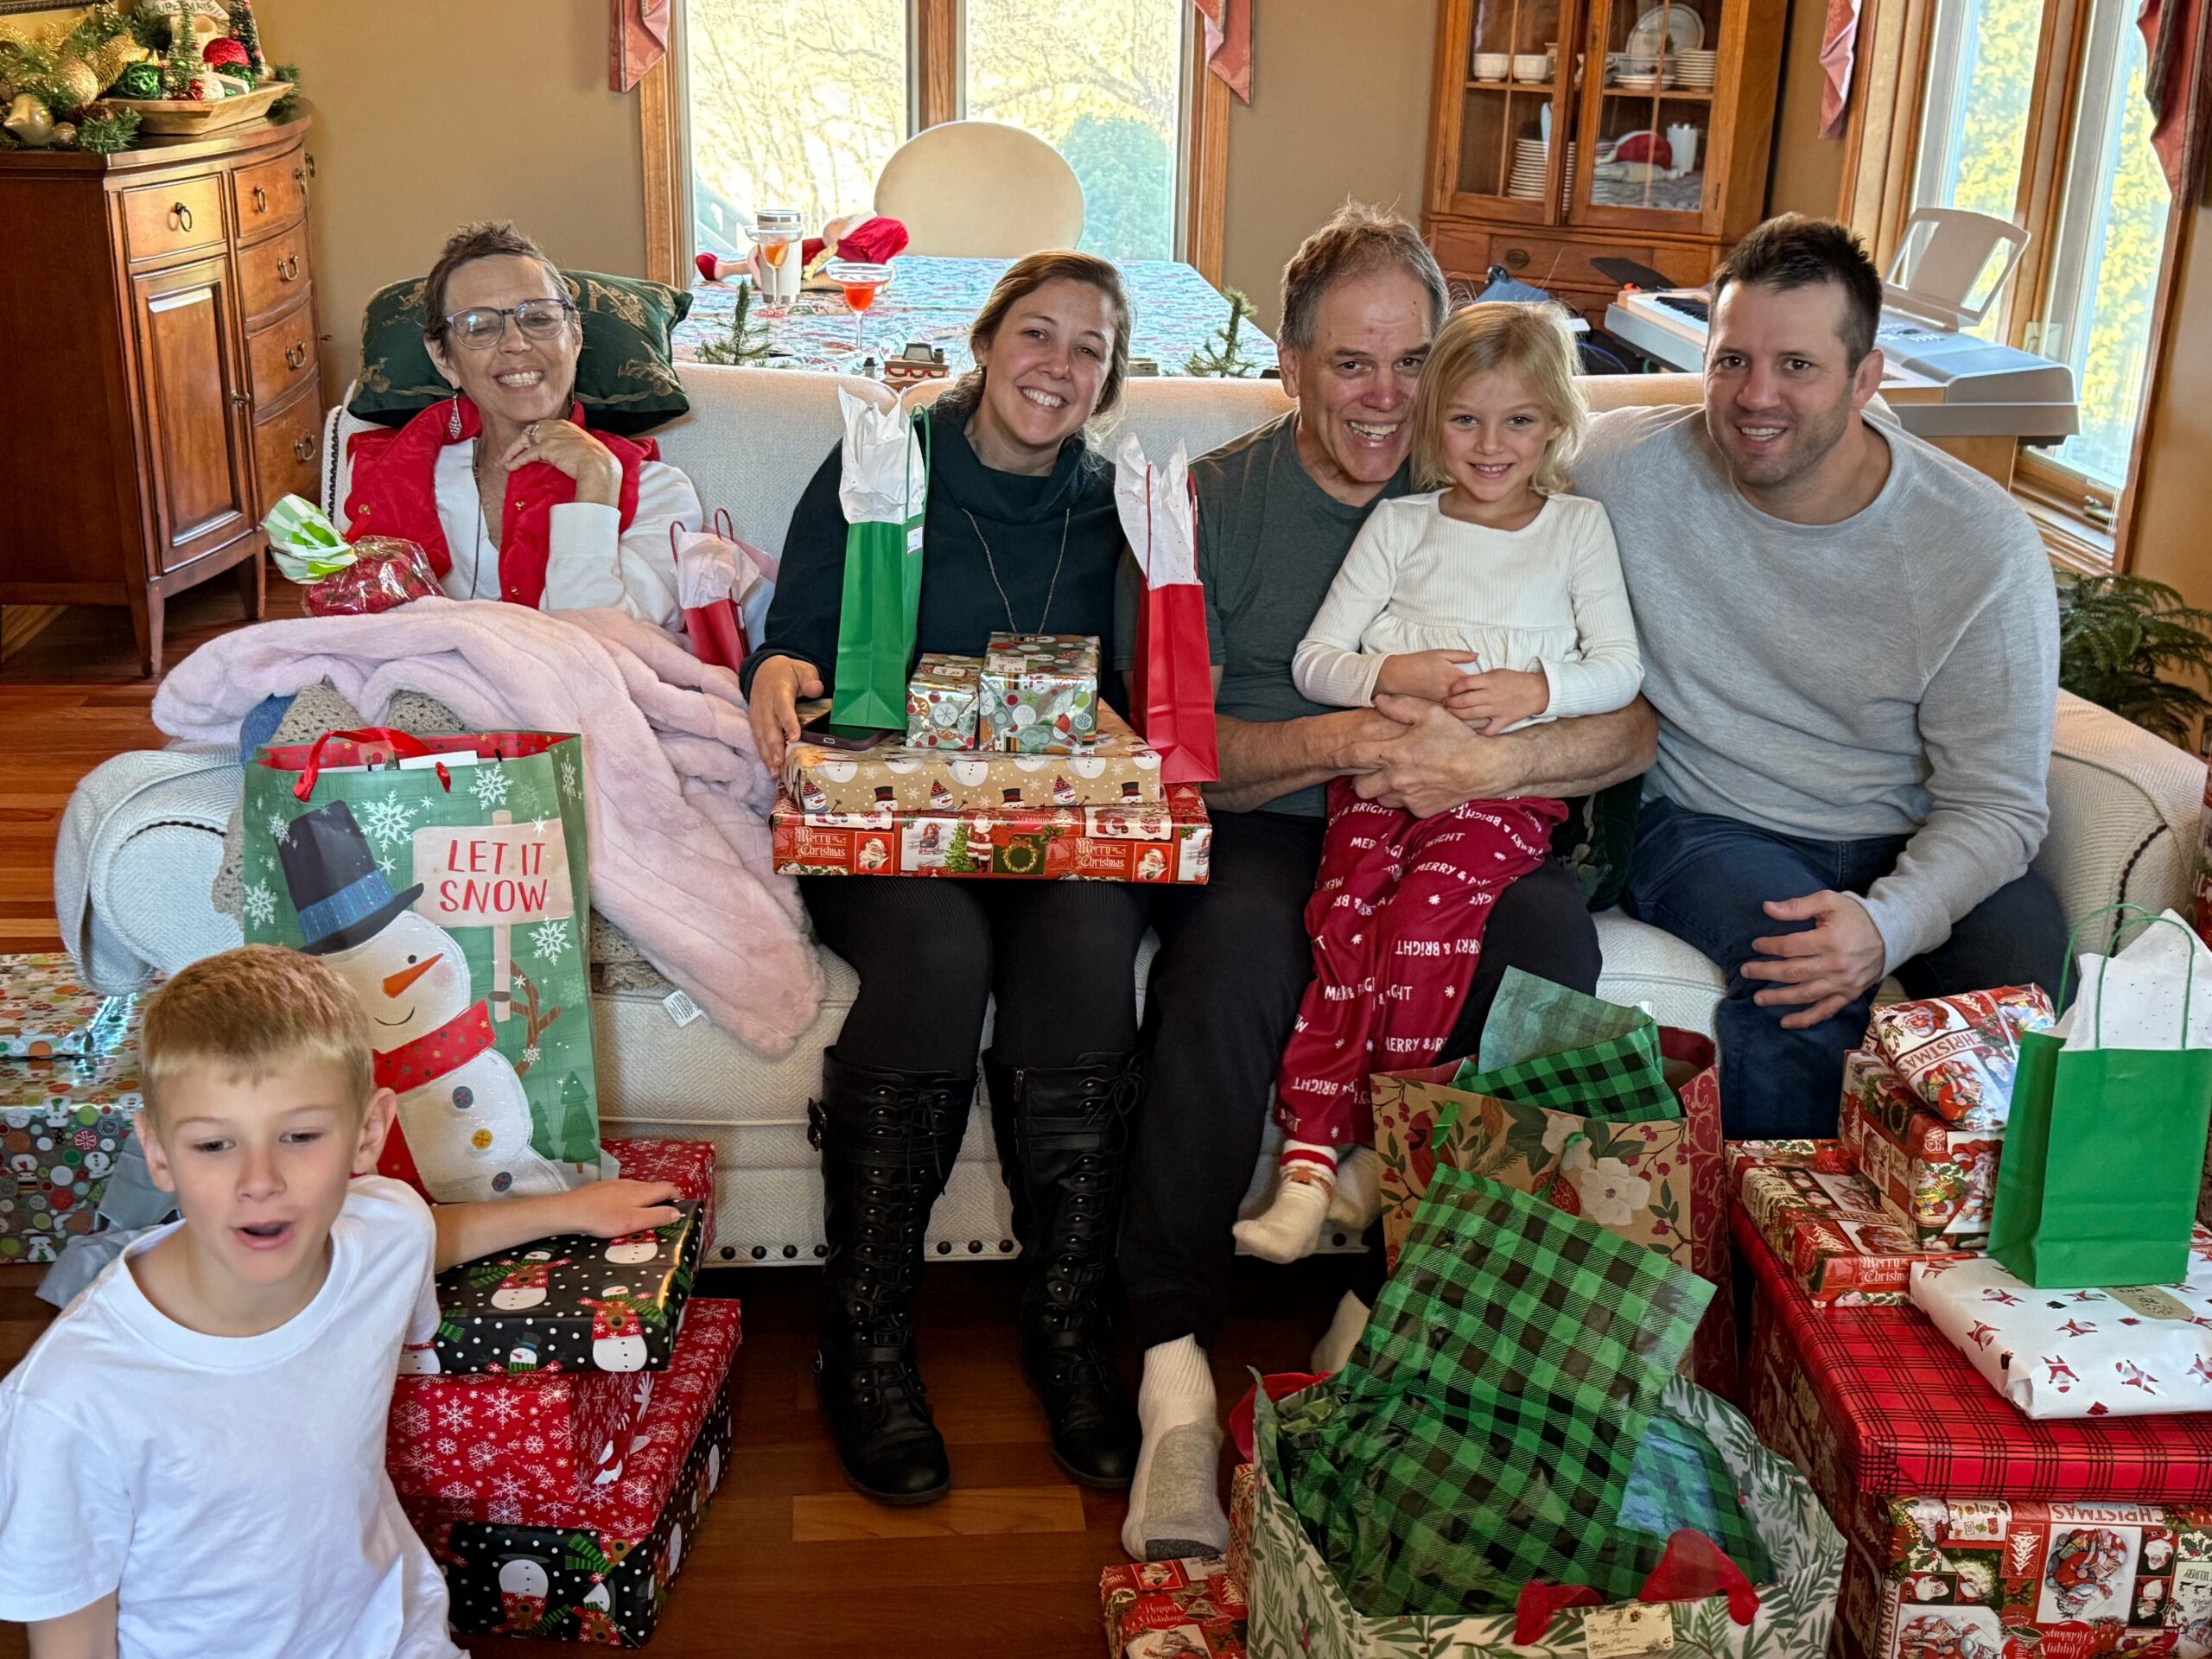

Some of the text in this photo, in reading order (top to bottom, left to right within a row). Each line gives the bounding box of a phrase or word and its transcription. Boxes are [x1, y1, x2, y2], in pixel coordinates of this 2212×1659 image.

[796, 827, 831, 844] Merry
[800, 844, 846, 858] Christmas
[1078, 839, 1111, 855] Merry
[448, 839, 546, 876] LET IT
[1080, 855, 1125, 868] Christmas
[439, 879, 548, 913] SNOW
[1900, 1031, 1982, 1077] CHRISTMAS
[2051, 1504, 2165, 1522] CHRISTMAS
